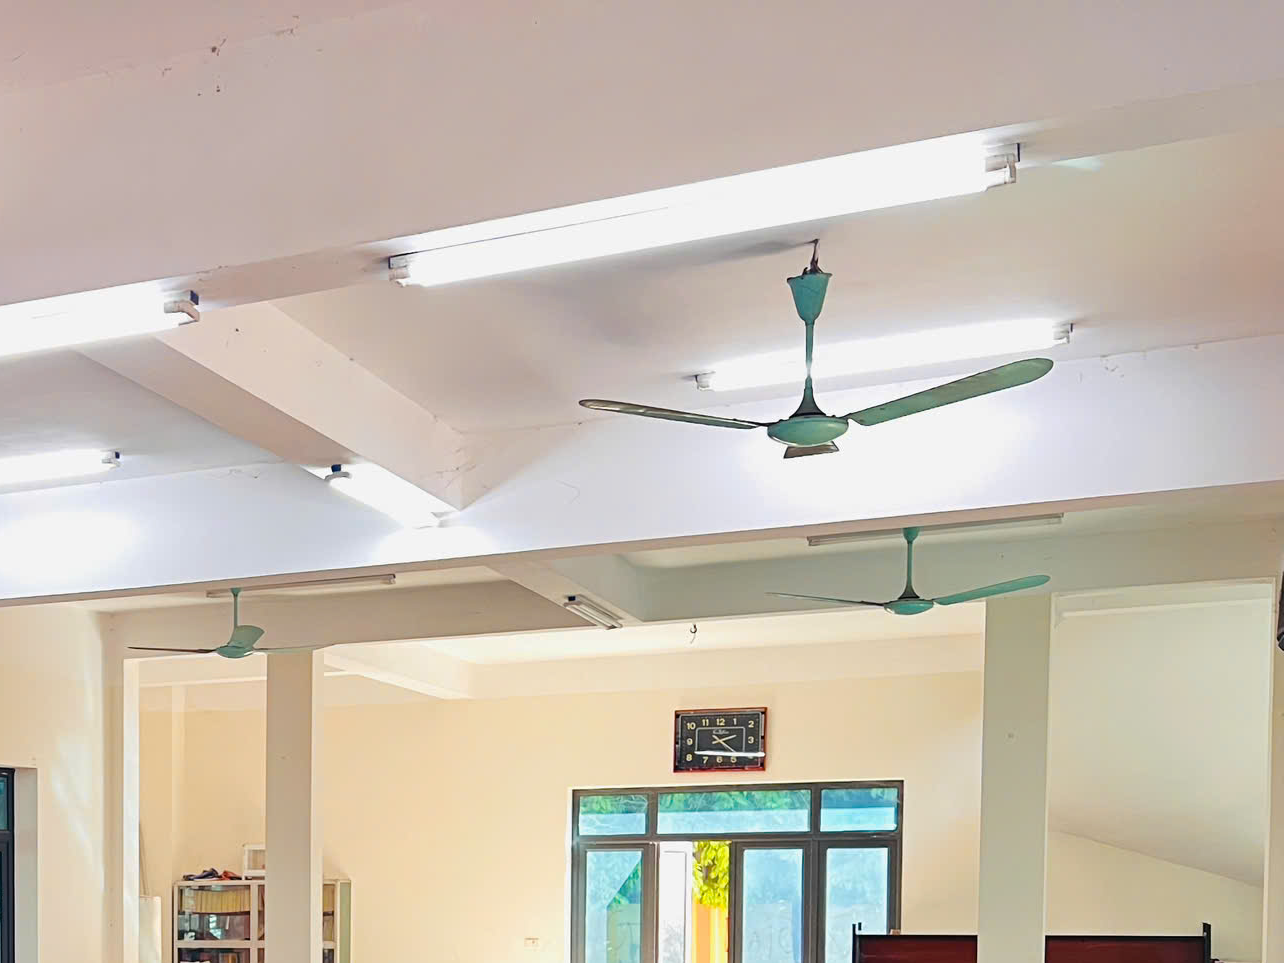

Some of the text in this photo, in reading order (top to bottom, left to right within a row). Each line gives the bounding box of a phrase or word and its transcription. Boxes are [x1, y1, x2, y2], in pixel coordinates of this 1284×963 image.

[716, 718, 725, 726] 12
[748, 720, 754, 728] 2
[748, 736, 754, 744] 3
